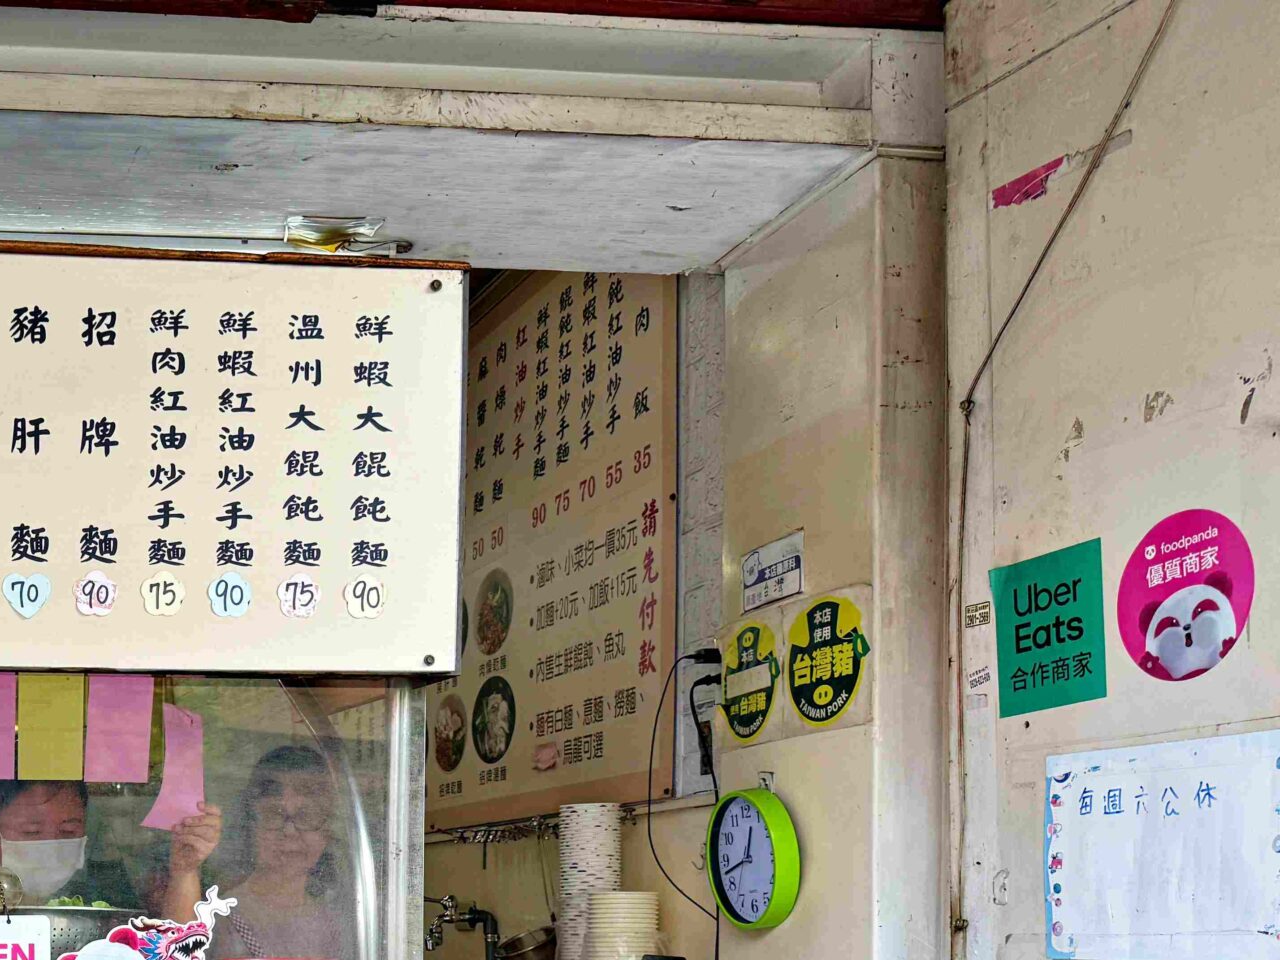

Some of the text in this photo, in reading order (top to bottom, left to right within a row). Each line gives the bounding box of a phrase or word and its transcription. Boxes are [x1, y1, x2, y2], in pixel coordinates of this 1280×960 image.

[9, 305, 51, 563] 豬肝麵
[79, 307, 119, 565] 招牌麵
[147, 308, 189, 567] 鮮肉紅油炒手麵
[216, 310, 258, 568] 鮮蝦紅油炒手麵
[282, 314, 325, 568] 溫州大餛飩麵
[350, 314, 394, 568] 鮮蝦大餛飩麵
[633, 444, 651, 474] 35
[579, 475, 596, 502] 70
[605, 460, 623, 489] 55
[531, 503, 546, 529] 90
[554, 489, 570, 516] 75
[472, 537, 484, 560] 50
[491, 526, 504, 550] 50
[1160, 525, 1219, 555] foodpanda
[1145, 545, 1220, 589] 優質商家
[11, 581, 39, 605] 70
[82, 580, 109, 607] 90
[149, 580, 176, 607] 75
[215, 579, 244, 608] 90
[285, 581, 314, 608] 75
[353, 580, 380, 611] 90
[638, 498, 659, 678] 請先付款
[1013, 577, 1082, 617] Uber
[813, 608, 832, 625] 本店
[813, 626, 832, 643] 使用
[1014, 613, 1085, 654] Eats
[793, 642, 854, 687] 台灣豬
[1010, 650, 1093, 693] 合作商家
[799, 689, 849, 719] TAIWAN PORK
[1079, 779, 1218, 817] 每週六公休
